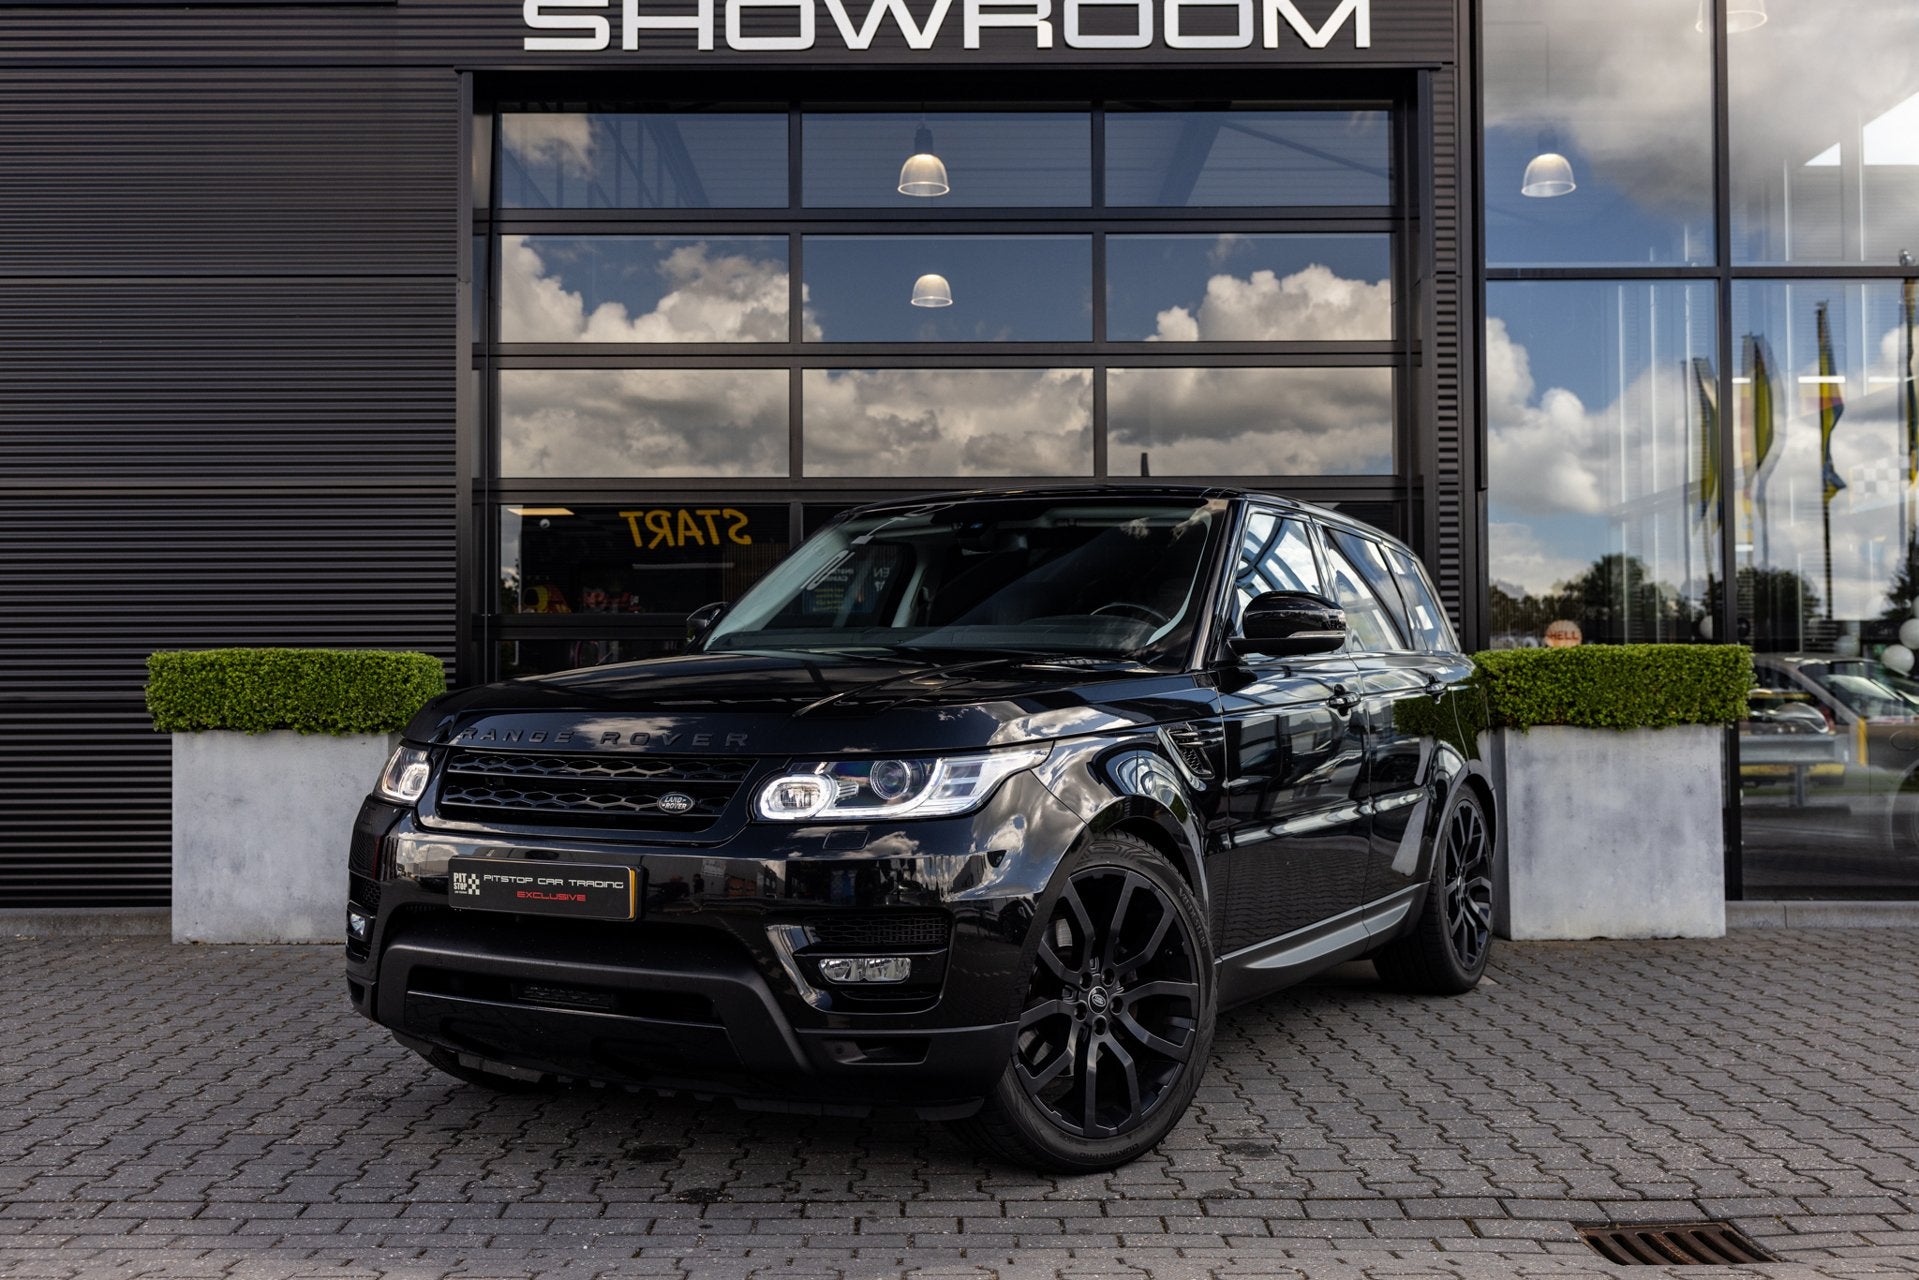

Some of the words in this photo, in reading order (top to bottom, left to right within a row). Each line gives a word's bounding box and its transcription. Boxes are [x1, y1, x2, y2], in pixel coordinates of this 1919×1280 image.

[523, 0, 1371, 51] SHOWROOM
[460, 727, 575, 744] RANGE
[600, 731, 748, 747] ROVER
[664, 802, 687, 810] ROVER
[453, 872, 467, 883] PIT
[483, 874, 533, 884] PITSTOP
[537, 877, 564, 886] CAR
[568, 879, 624, 889] TRADING
[453, 882, 468, 890] STOP
[516, 890, 586, 902] EXCLUSIVE
